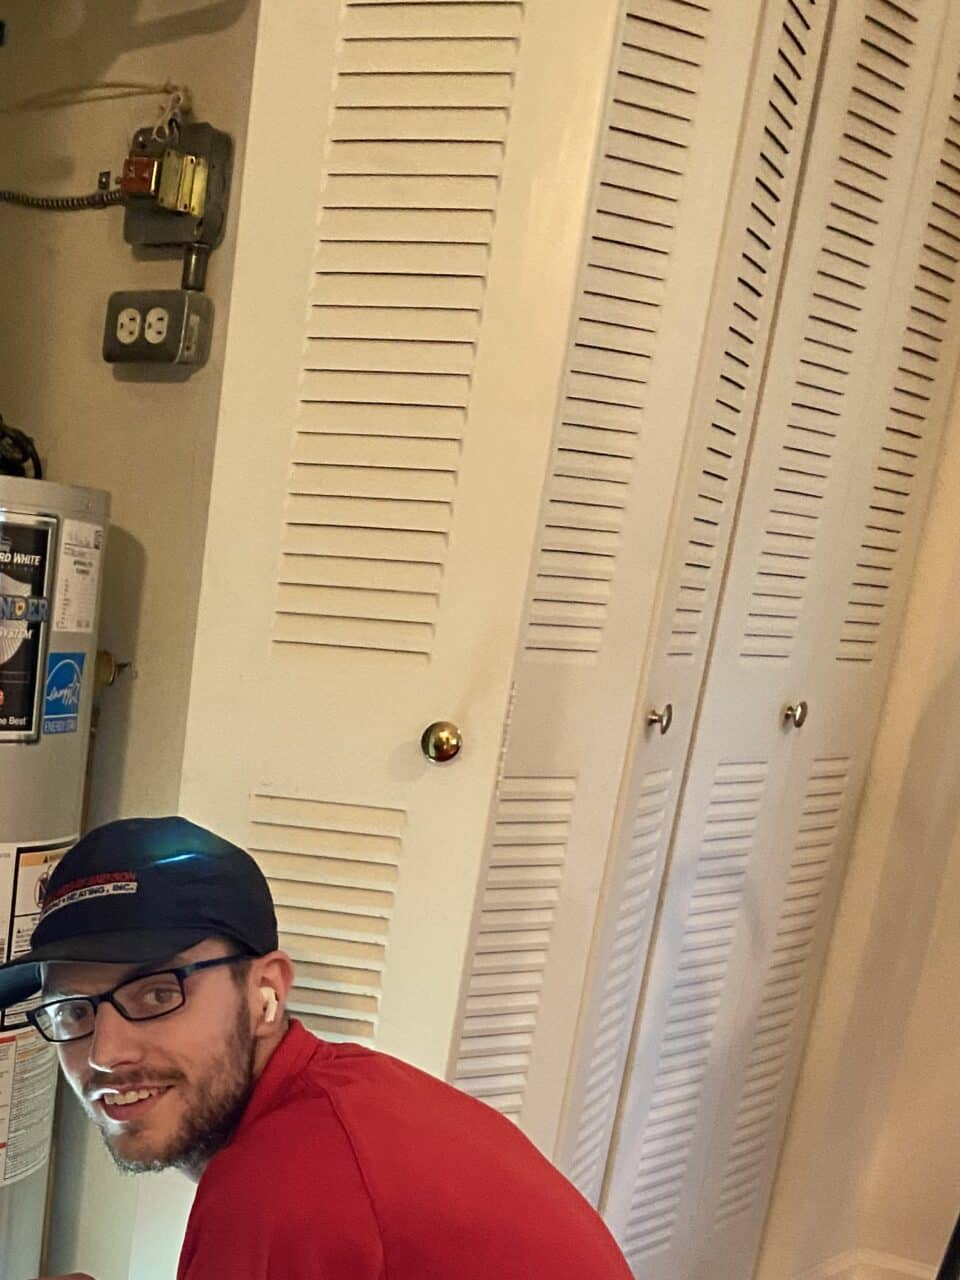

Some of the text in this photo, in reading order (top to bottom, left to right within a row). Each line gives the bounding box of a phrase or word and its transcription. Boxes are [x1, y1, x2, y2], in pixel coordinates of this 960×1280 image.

[13, 552, 41, 565] WHITE
[8, 716, 26, 725] Best
[66, 883, 134, 901] HEATING, INC.
